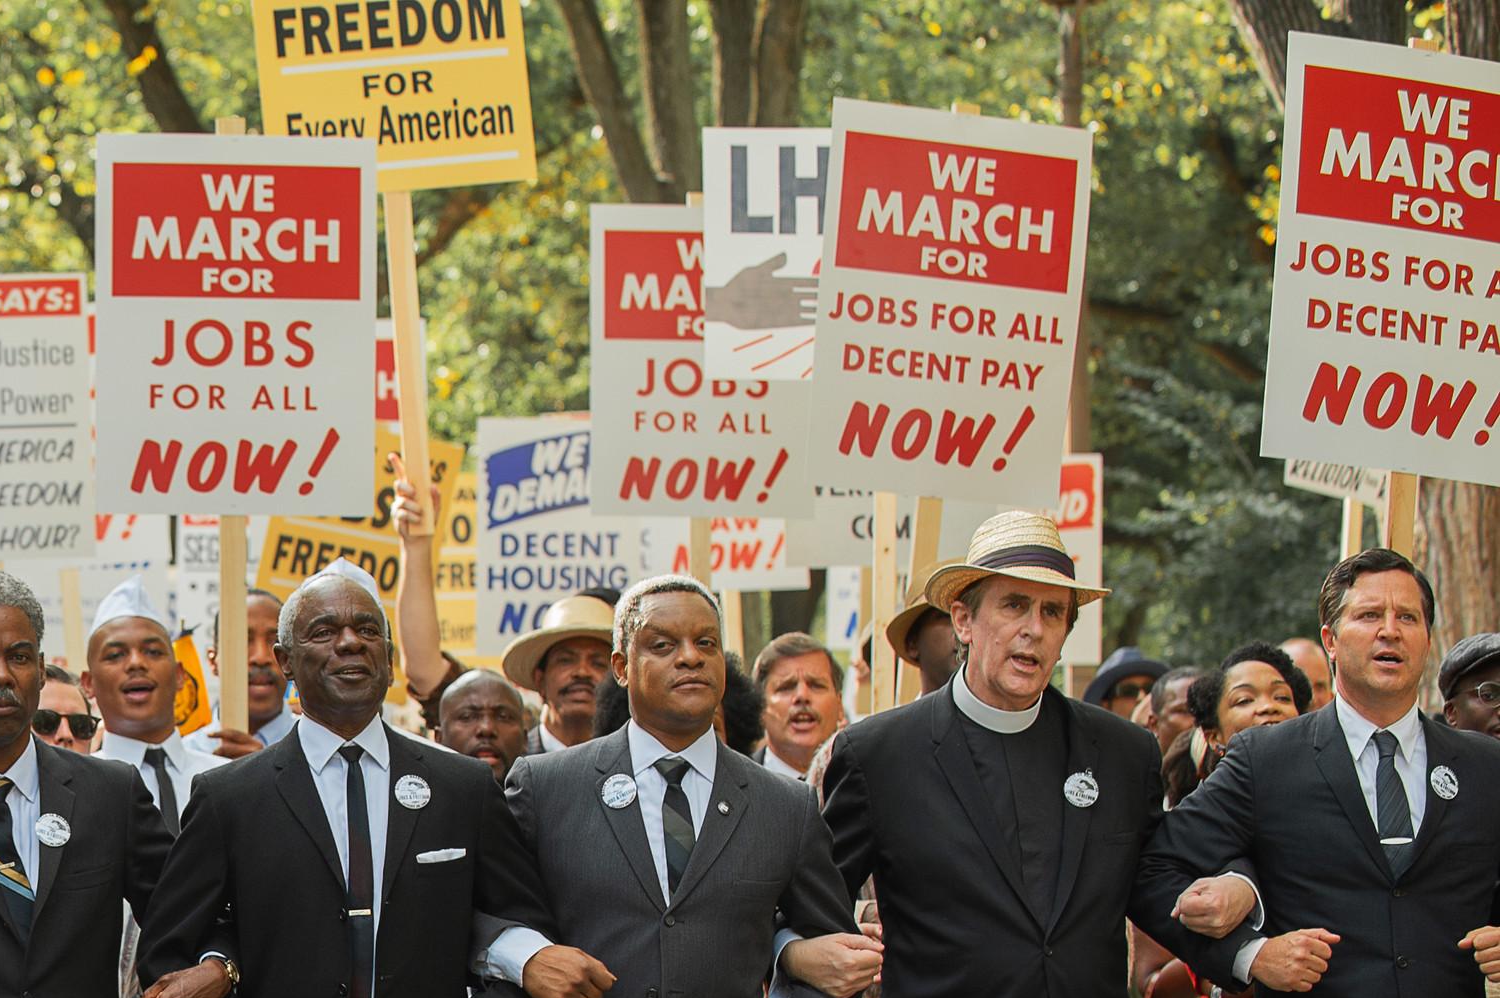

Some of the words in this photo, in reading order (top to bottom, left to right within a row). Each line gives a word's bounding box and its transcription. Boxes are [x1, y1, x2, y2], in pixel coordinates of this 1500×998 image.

[273, 0, 505, 58] FREEDOM
[362, 70, 434, 98] FOR
[378, 98, 514, 145] American
[1398, 89, 1470, 141] WE
[928, 151, 997, 197] WE
[1319, 127, 1500, 200] MARC
[201, 173, 275, 213] WE
[1392, 193, 1464, 230] FOR
[131, 216, 341, 264] MARCH
[857, 188, 1054, 254] MARCH
[202, 267, 275, 294] FOR
[920, 246, 988, 278] FOR
[1290, 241, 1390, 283] JOBS
[1404, 256, 1474, 296] FOR
[620, 273, 704, 311] MA
[828, 292, 918, 328] JOBS
[931, 303, 997, 337] FOR
[1007, 313, 1064, 345] ALL
[1307, 298, 1448, 346] DECENT
[152, 319, 315, 368] JOBS
[842, 343, 971, 383] DECENT
[980, 359, 1044, 392] PAY
[1, 387, 75, 416] Power
[149, 384, 226, 411] FOR
[251, 385, 318, 411] ALL
[634, 411, 697, 432] FOR
[719, 413, 772, 434] ALL
[838, 400, 1036, 472] NOW!
[130, 427, 340, 496] NOW!
[530, 434, 589, 476] WE
[619, 448, 789, 503] NOW!
[0, 524, 81, 551] HOUR?
[500, 533, 620, 558] DECENT
[487, 565, 629, 591] HOUSING
